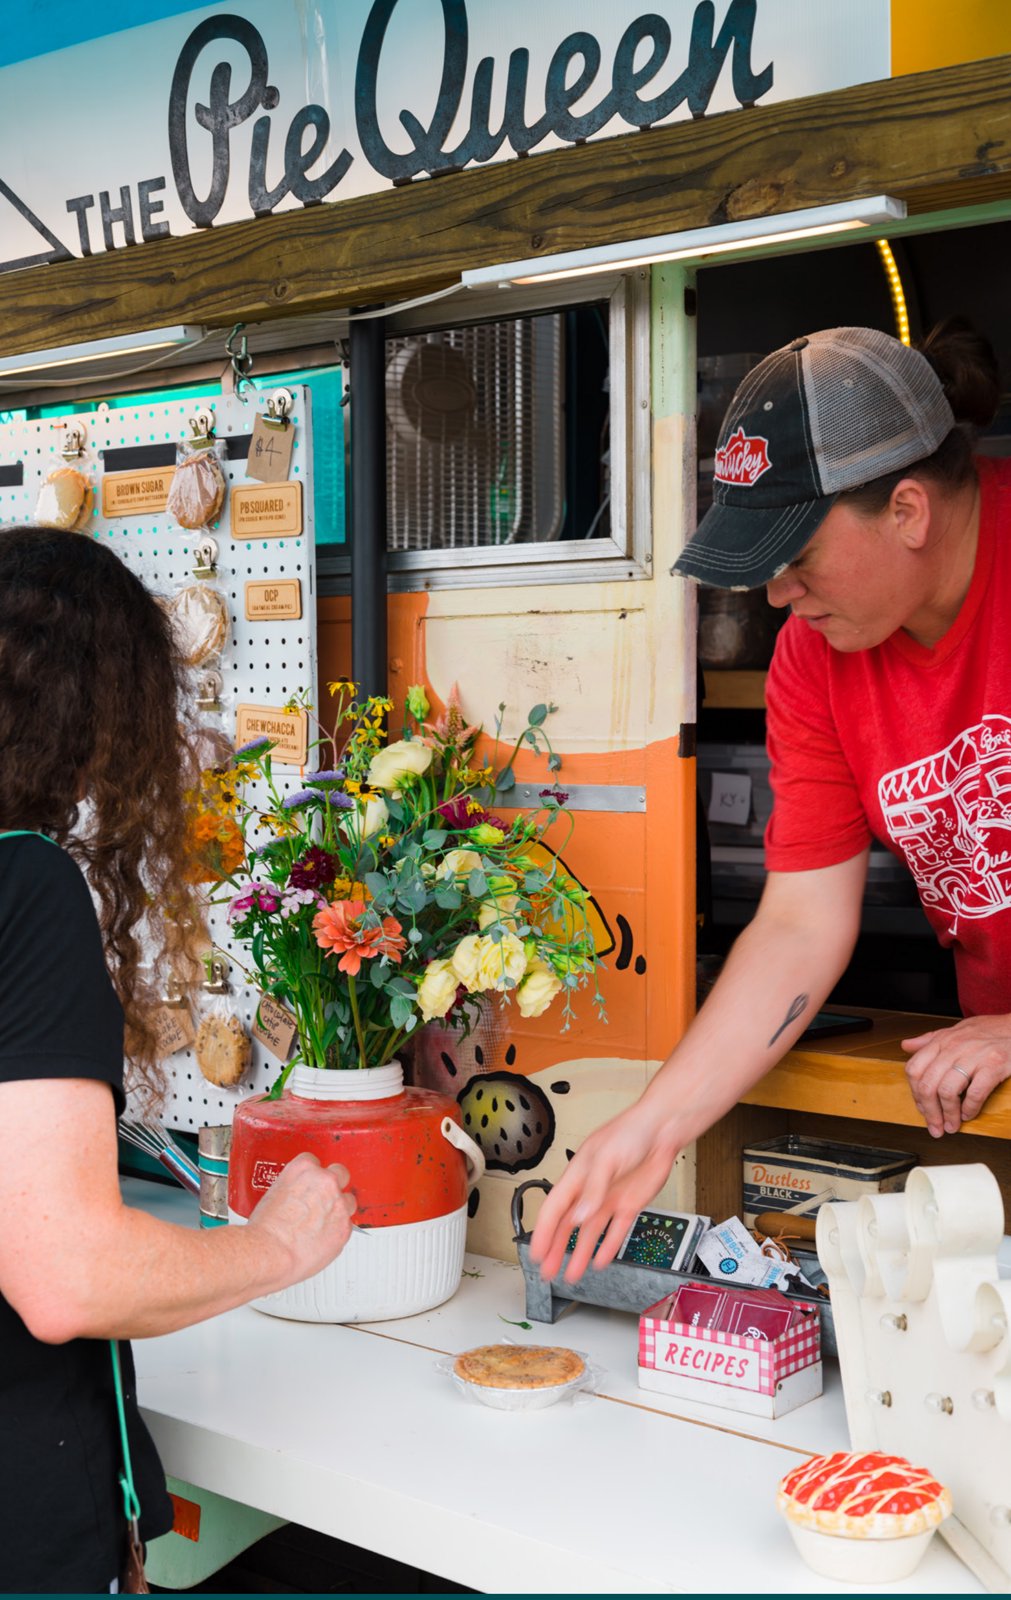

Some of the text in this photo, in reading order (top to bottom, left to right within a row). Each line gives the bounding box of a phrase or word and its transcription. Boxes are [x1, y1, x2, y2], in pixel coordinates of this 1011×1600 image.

[66, 0, 774, 256] THE Pie Queen
[255, 436, 282, 467] $4
[116, 479, 164, 497] BROWN SUGAR
[250, 498, 284, 513] SQUARED
[264, 590, 278, 602] OCP
[246, 718, 296, 736] CHEWCHACCA
[752, 1164, 812, 1191] Dustless
[760, 1186, 792, 1199] BLACK
[664, 1342, 750, 1378] RECIPES
